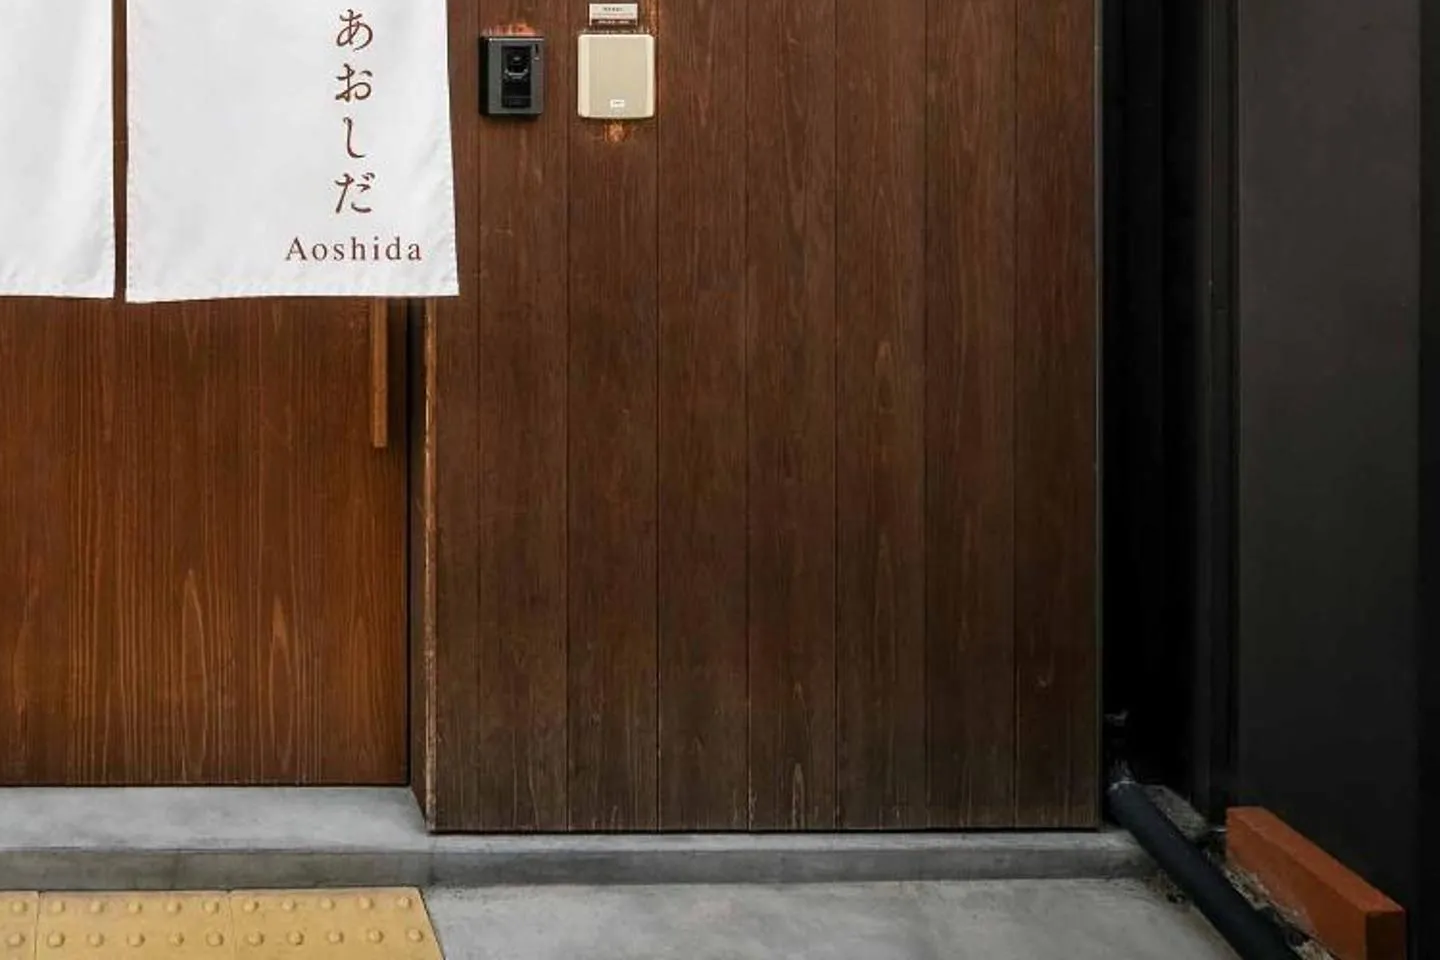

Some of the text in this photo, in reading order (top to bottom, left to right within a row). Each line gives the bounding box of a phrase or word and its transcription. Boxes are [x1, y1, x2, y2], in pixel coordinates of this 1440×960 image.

[334, 8, 376, 214] あおしだ
[285, 236, 422, 262] Aoshida
